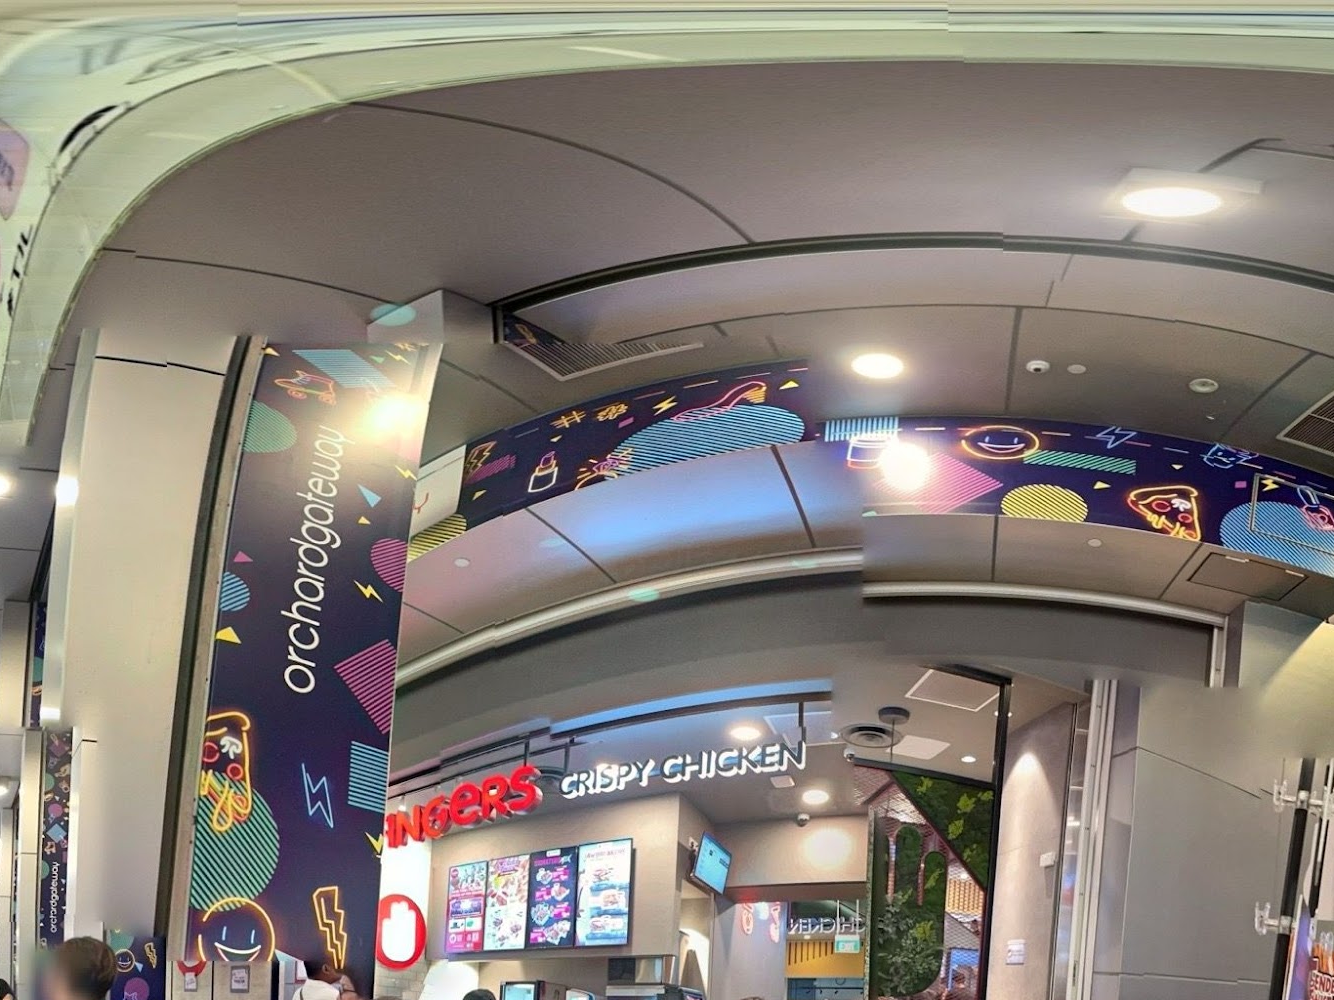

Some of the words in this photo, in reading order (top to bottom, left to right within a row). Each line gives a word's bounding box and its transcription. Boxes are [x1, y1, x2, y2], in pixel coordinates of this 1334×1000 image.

[283, 424, 356, 694] orchardgateway
[558, 758, 656, 800] CRISPY
[660, 740, 807, 784] CHICKEN
[49, 861, 61, 934] orchardgateway
